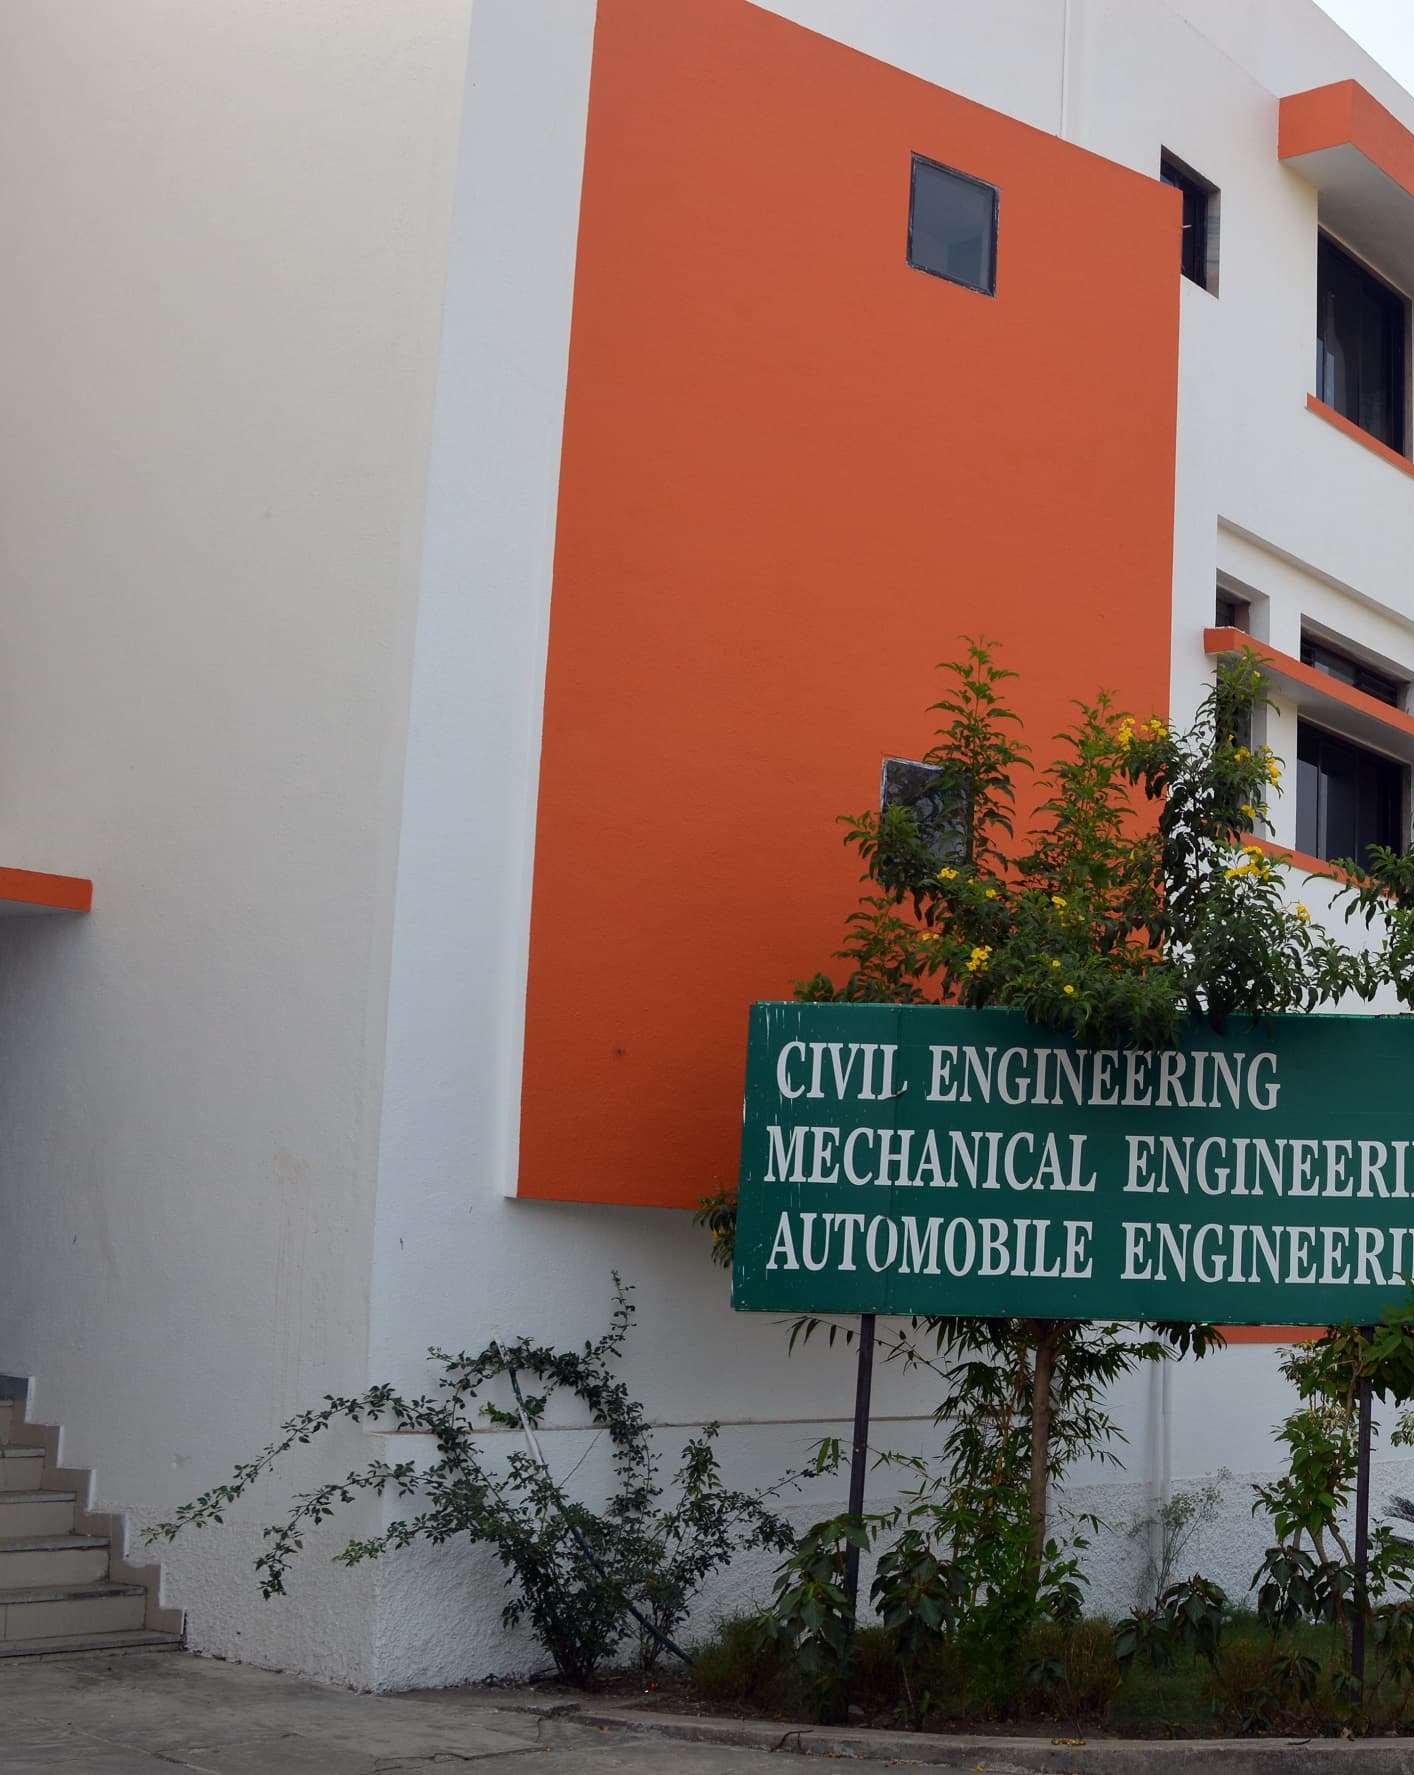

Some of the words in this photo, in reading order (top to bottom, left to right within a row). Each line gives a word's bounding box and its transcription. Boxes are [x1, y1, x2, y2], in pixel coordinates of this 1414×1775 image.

[776, 1040, 908, 1101] CIVIL
[926, 1045, 1282, 1111] ENGINEERING
[763, 1125, 1097, 1193] MECHANICAL
[765, 1211, 1093, 1279] AUTOMOBILE
